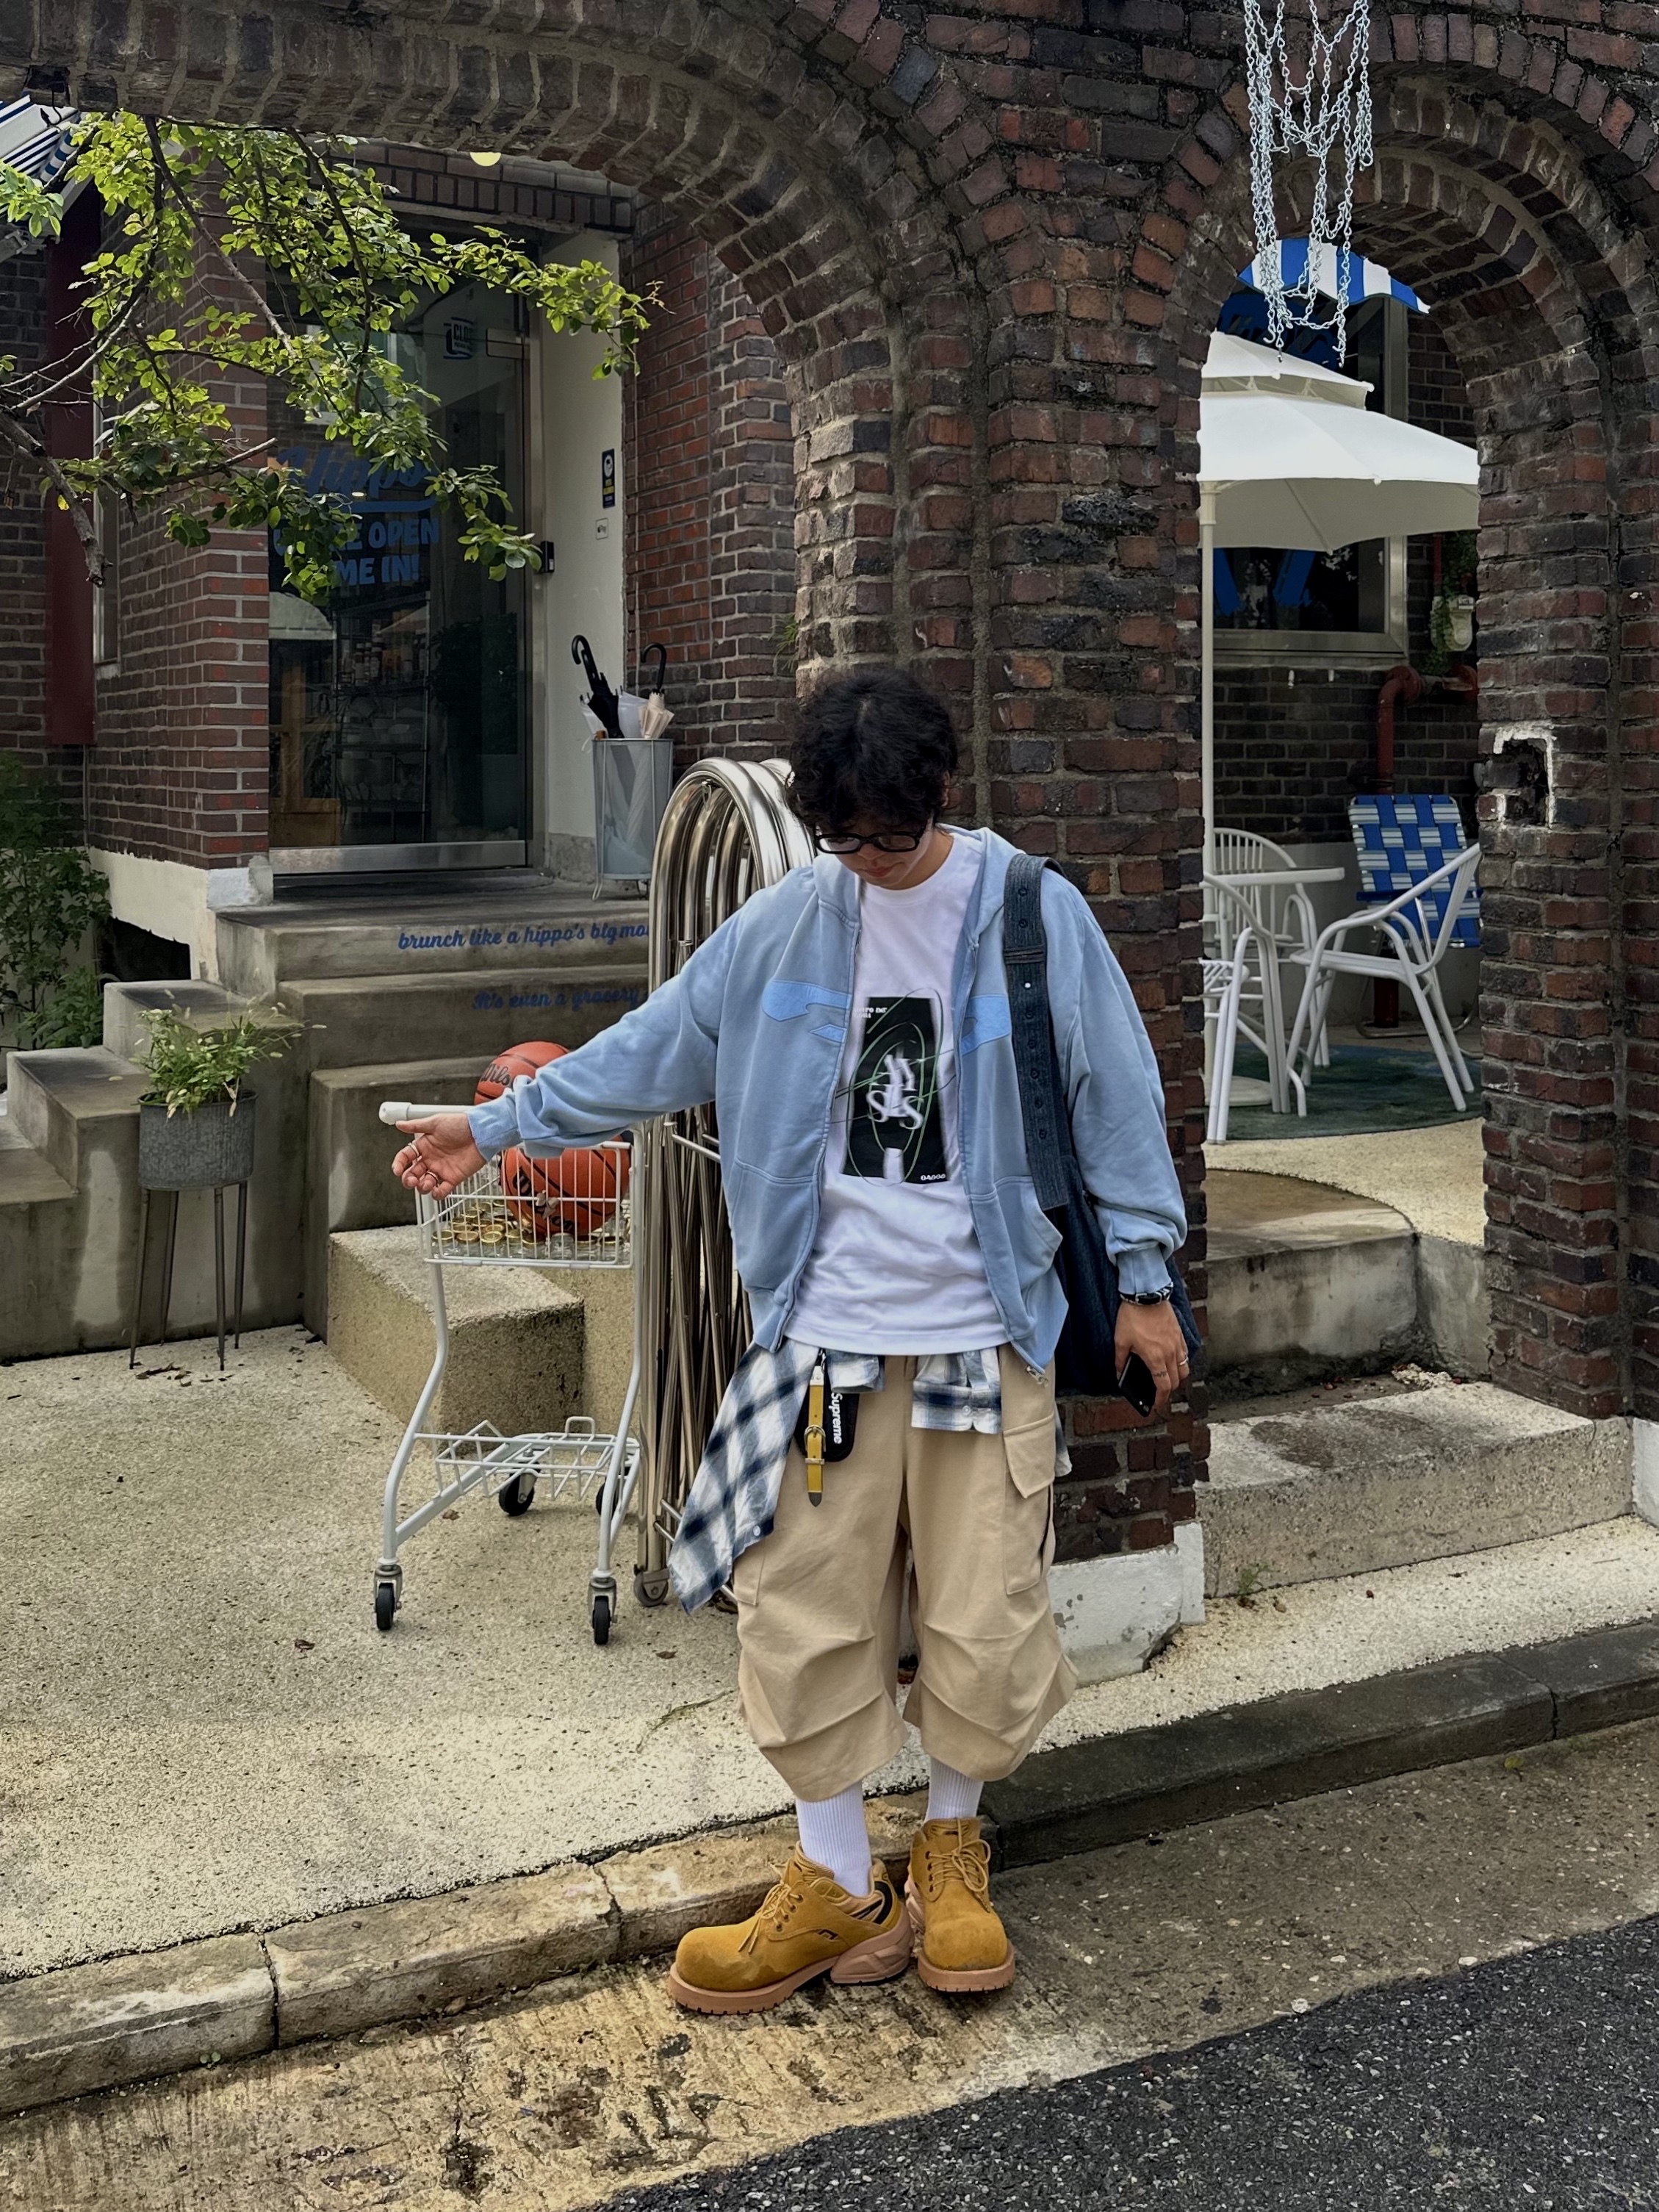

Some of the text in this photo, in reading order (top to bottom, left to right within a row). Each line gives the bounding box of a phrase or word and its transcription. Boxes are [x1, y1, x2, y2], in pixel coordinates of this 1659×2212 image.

[368, 517, 440, 549] OPEN
[381, 553, 420, 583] IN!
[397, 930, 467, 949] brunch
[469, 927, 503, 947] like
[507, 932, 520, 944] a
[524, 924, 586, 948] hippo's
[508, 993, 552, 1009] even
[555, 993, 568, 1006] a
[572, 989, 641, 1011] grocery
[828, 1392, 843, 1445] Supreme
